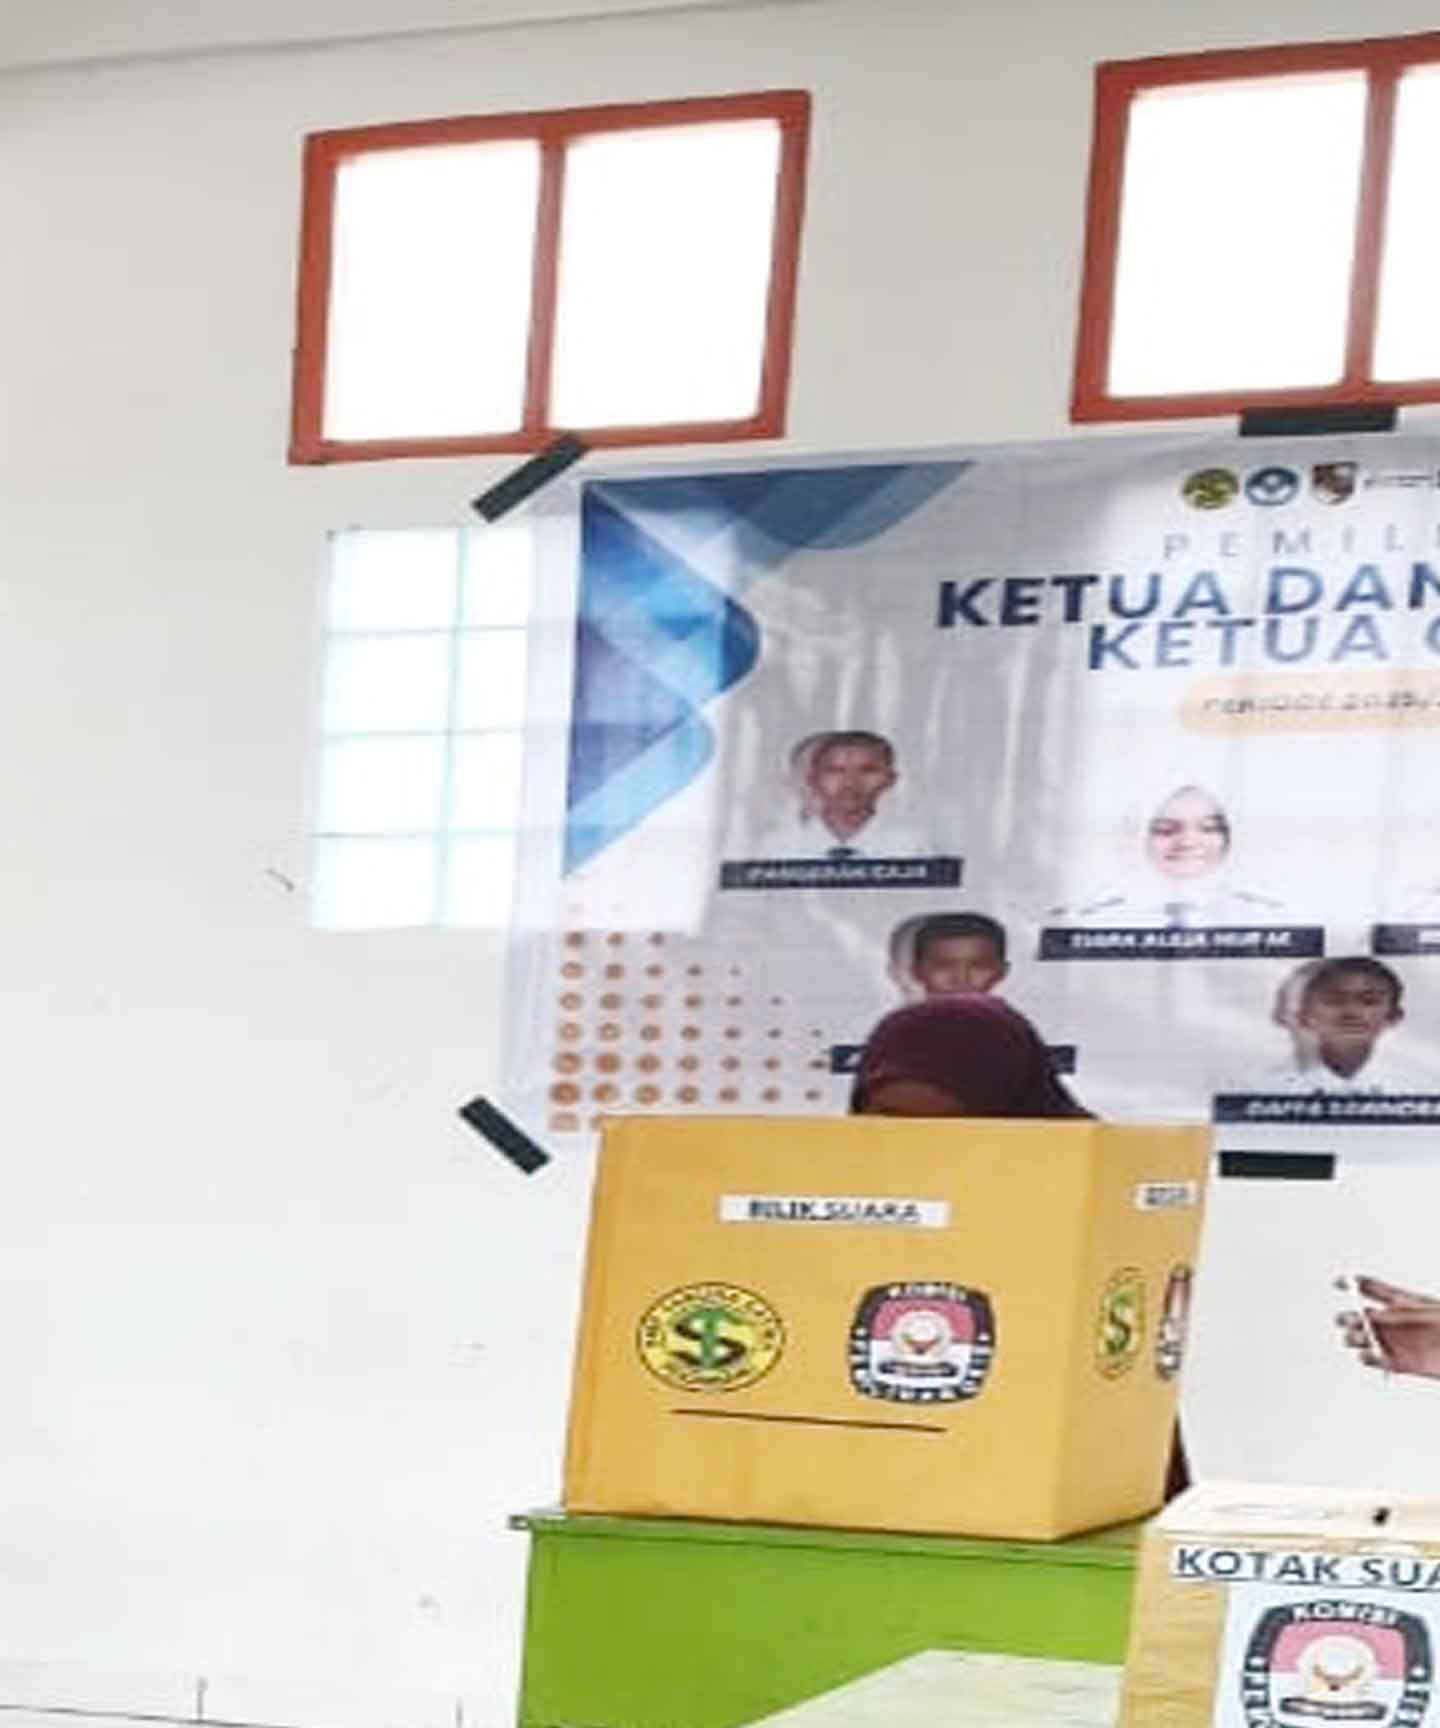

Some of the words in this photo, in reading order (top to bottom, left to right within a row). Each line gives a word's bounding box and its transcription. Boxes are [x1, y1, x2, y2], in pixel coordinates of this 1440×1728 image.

[937, 570, 1232, 628] KETUA
[1087, 615, 1388, 670] KETUA
[1177, 1547, 1341, 1583] KOTAK
